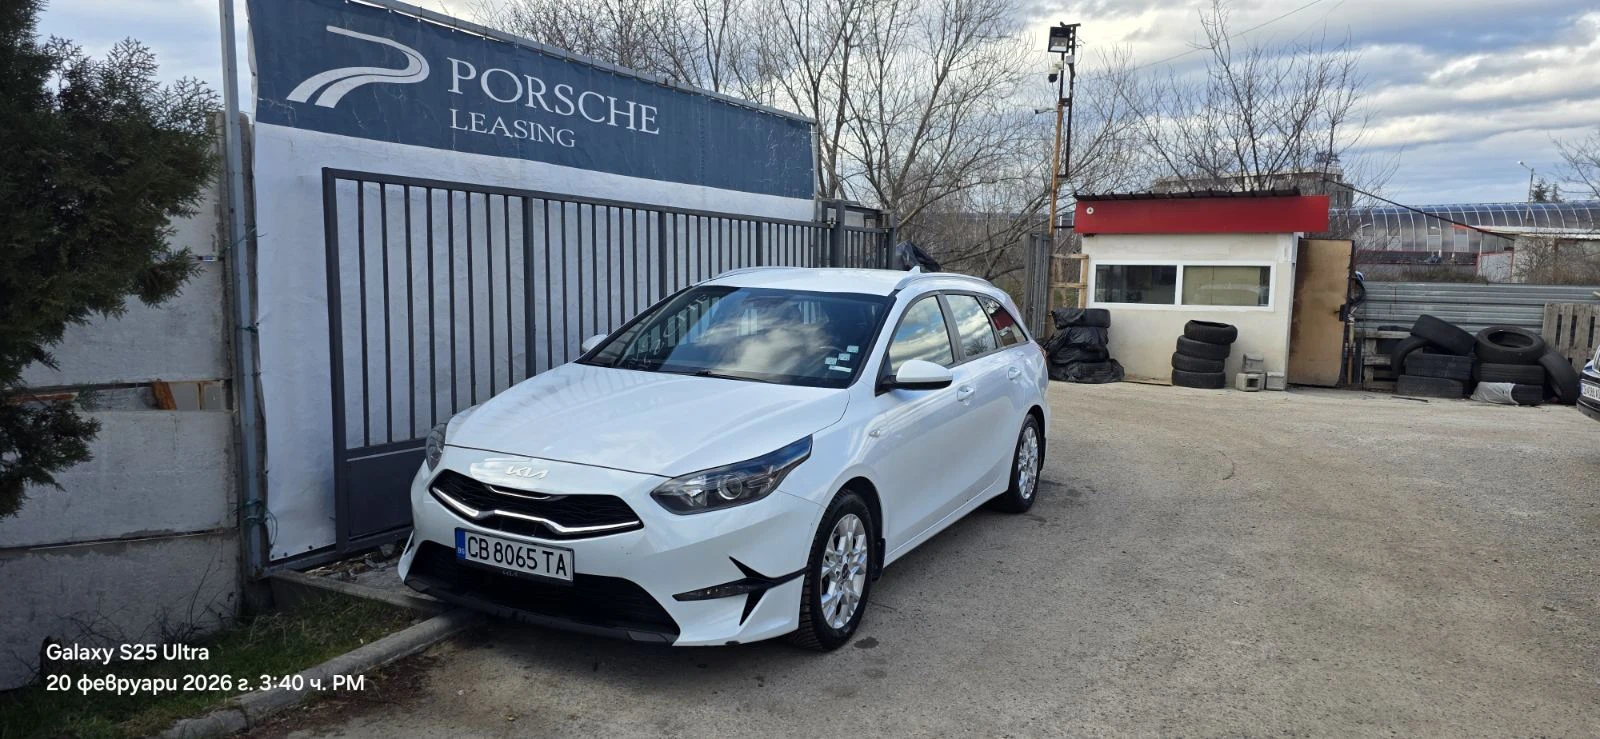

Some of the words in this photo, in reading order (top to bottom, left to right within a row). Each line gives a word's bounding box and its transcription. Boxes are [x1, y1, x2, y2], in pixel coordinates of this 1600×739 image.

[447, 57, 660, 135] PORSCHE
[450, 108, 575, 148] LEASING
[467, 536, 489, 561] CB
[493, 541, 538, 570] 8065
[542, 550, 568, 576] TA
